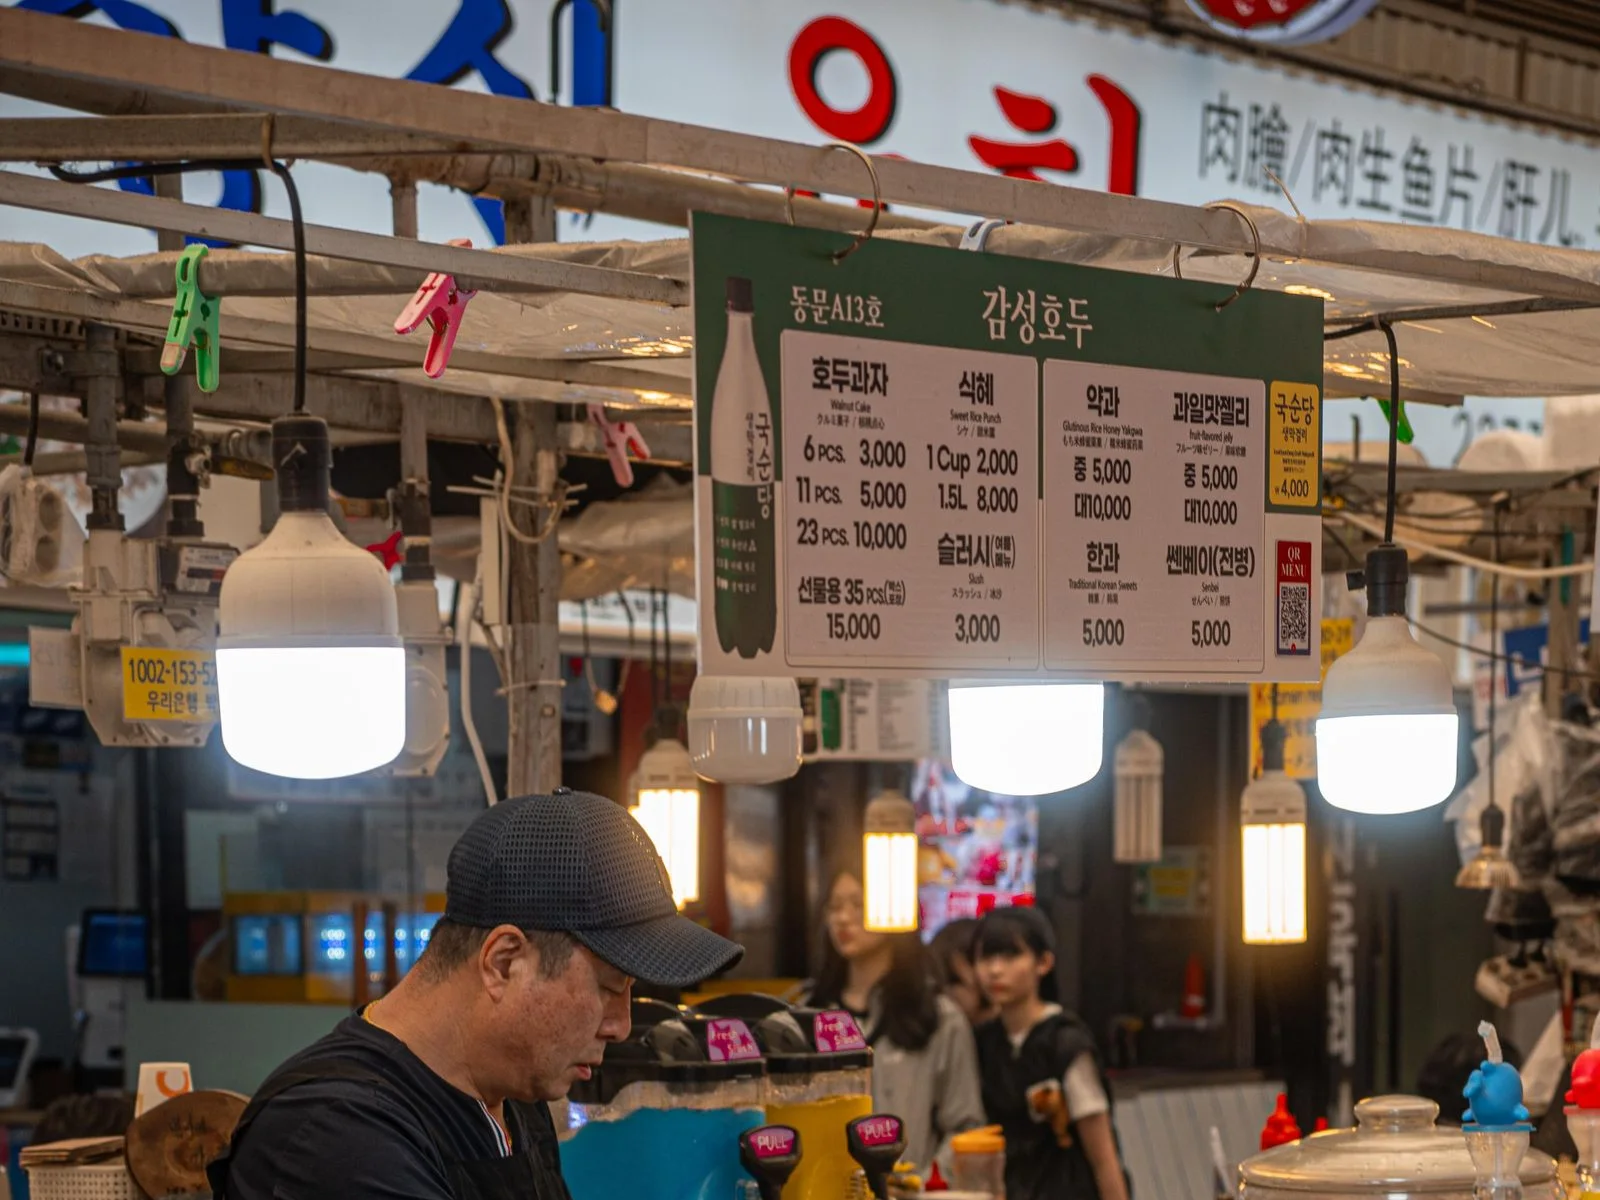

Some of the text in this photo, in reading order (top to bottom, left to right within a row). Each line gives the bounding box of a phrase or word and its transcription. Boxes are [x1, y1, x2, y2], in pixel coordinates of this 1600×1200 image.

[790, 286, 884, 327] 동문A13호
[982, 286, 1093, 349] 감성호두
[812, 356, 889, 396] 호두과자
[959, 371, 994, 406] 식혜
[830, 399, 871, 413] Walnut Cake
[1086, 384, 1120, 417] 약과
[1173, 392, 1249, 427] 과일맛젤리
[1274, 393, 1314, 425] 국순당
[950, 409, 1001, 424] Sweet Rice Punch
[1063, 420, 1090, 433] Glutinous
[1091, 422, 1102, 434] Rice
[1103, 424, 1121, 436] Honey
[756, 412, 772, 519] 국순당
[804, 434, 815, 462] 6
[860, 438, 906, 468] 3,000
[927, 444, 1018, 479] 1 Cup 2,000
[1074, 456, 1131, 485] 중 5,000
[1184, 463, 1238, 491] 중 5,000
[796, 476, 810, 503] 11
[860, 480, 906, 510] 5,000
[938, 483, 1018, 514] 1.5L 8,000
[797, 518, 818, 545] 23
[853, 521, 907, 550] 10,000
[938, 532, 990, 567] 슬러시
[1086, 541, 1120, 573] 한과
[1287, 546, 1300, 561] QR
[1069, 578, 1138, 591] Traditional Korean Sweets
[1282, 563, 1306, 577] MENU
[798, 576, 841, 604] 선물용
[844, 578, 863, 605] 35
[826, 612, 881, 641] 15,000
[955, 613, 1000, 644] 3,000
[1083, 618, 1124, 647] 5,000
[1192, 620, 1231, 648] 5,000
[757, 1135, 789, 1151] PULL
[864, 1120, 893, 1140] PULL
